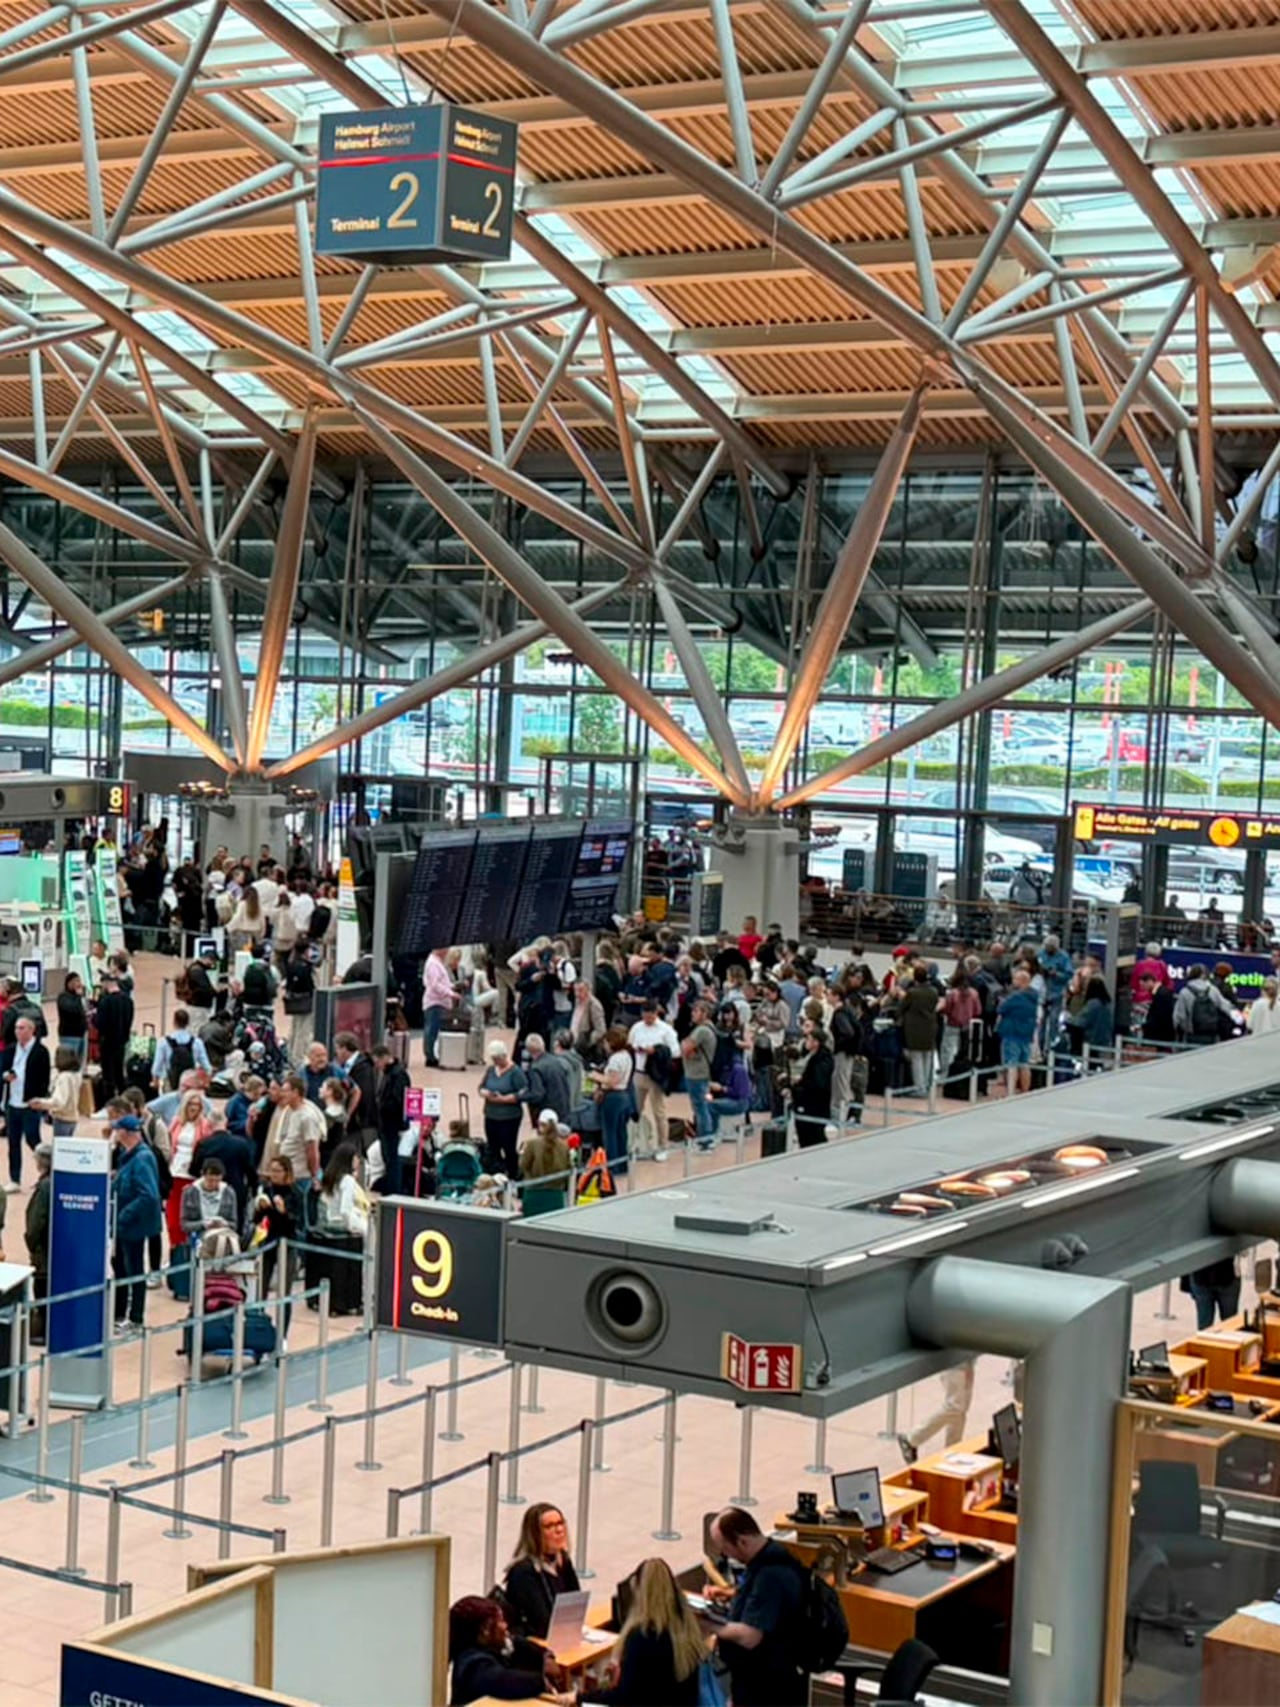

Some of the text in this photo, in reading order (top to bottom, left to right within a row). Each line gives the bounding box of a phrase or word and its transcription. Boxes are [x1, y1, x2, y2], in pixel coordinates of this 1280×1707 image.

[335, 121, 416, 137] Hamburg Airport
[334, 134, 411, 150] Helmut Schmidt
[387, 172, 419, 229] 2
[483, 182, 502, 238] 2
[331, 217, 380, 232] Terminal
[450, 215, 480, 234] Terminal
[110, 786, 122, 808] 8
[1095, 812, 1116, 824] Alle
[1117, 813, 1147, 826] Gates
[1154, 816, 1170, 828] All
[1170, 819, 1200, 831] gates
[58, 1193, 99, 1203] CUSTOMER
[62, 1202, 95, 1211] SERVICE
[411, 1229, 453, 1298] 9
[411, 1302, 459, 1322] Check-in
